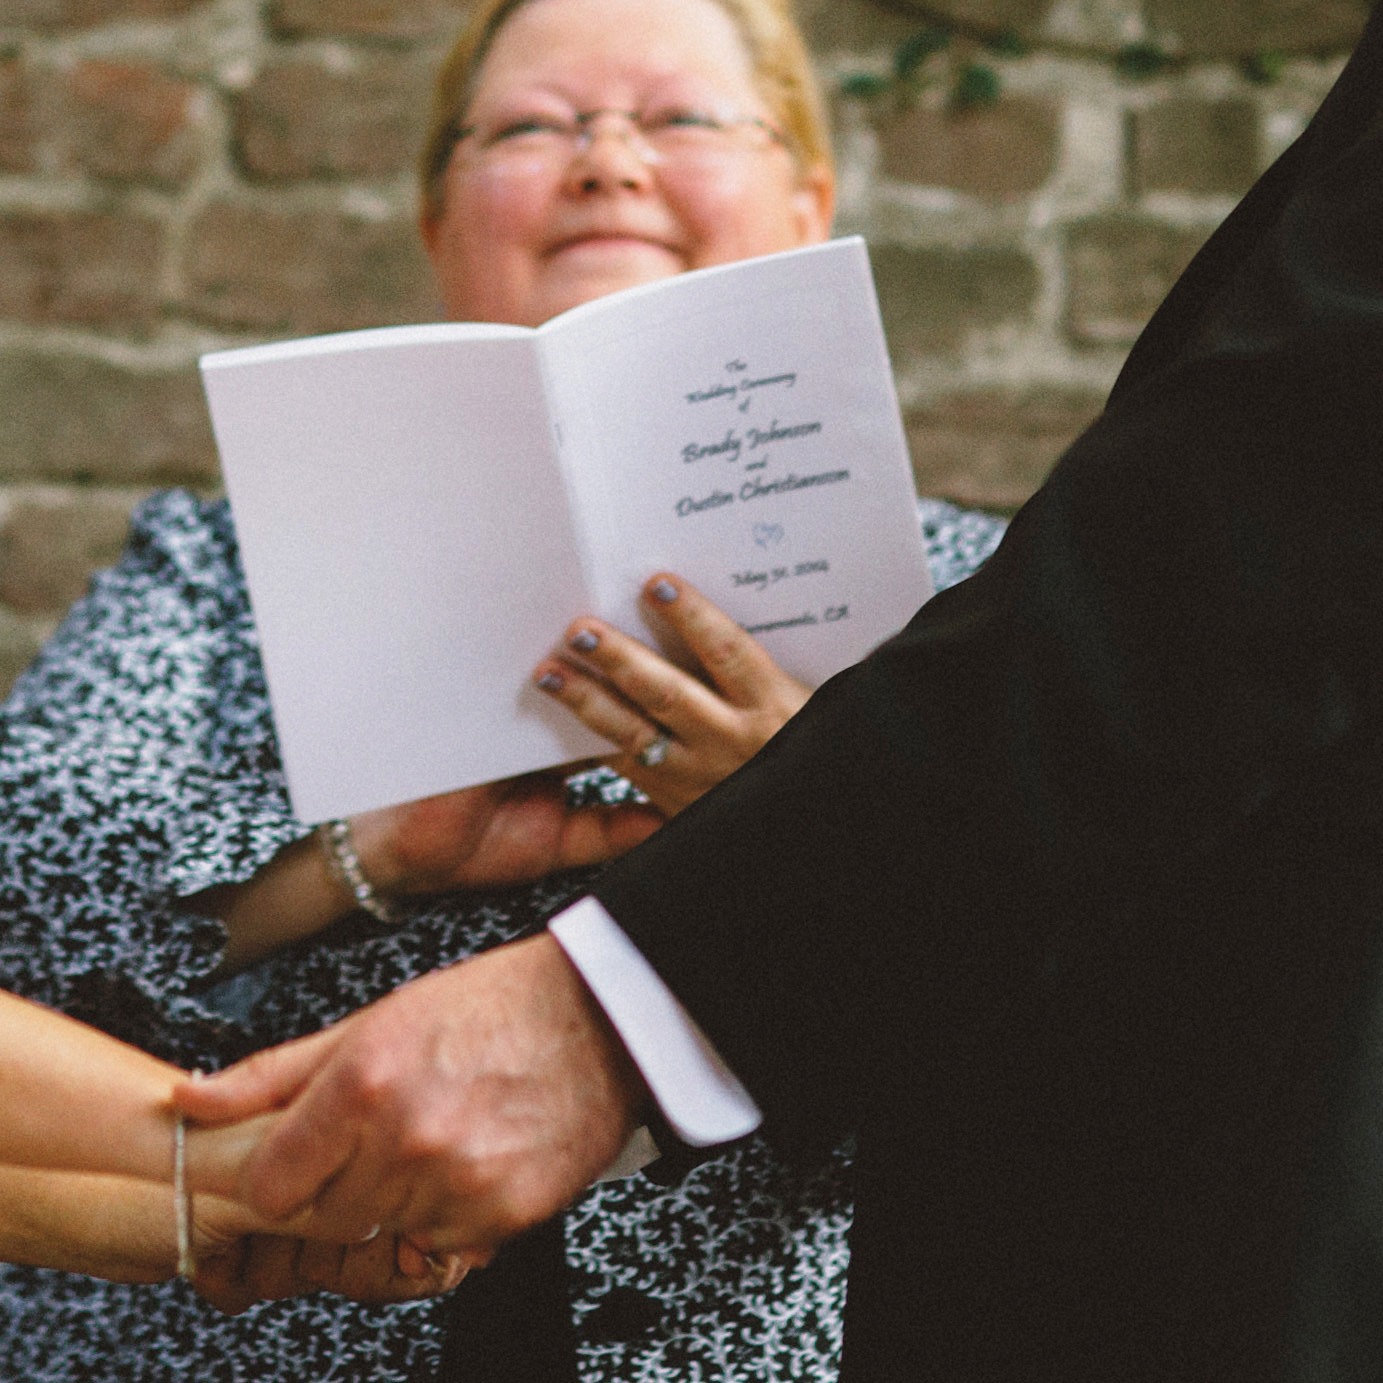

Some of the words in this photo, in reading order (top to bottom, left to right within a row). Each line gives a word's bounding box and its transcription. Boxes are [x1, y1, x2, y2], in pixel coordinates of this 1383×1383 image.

[684, 384, 738, 404] Wedding
[680, 428, 742, 464] Brady
[746, 417, 822, 450] Johnson
[674, 488, 734, 517] Dustin
[730, 569, 768, 592] May
